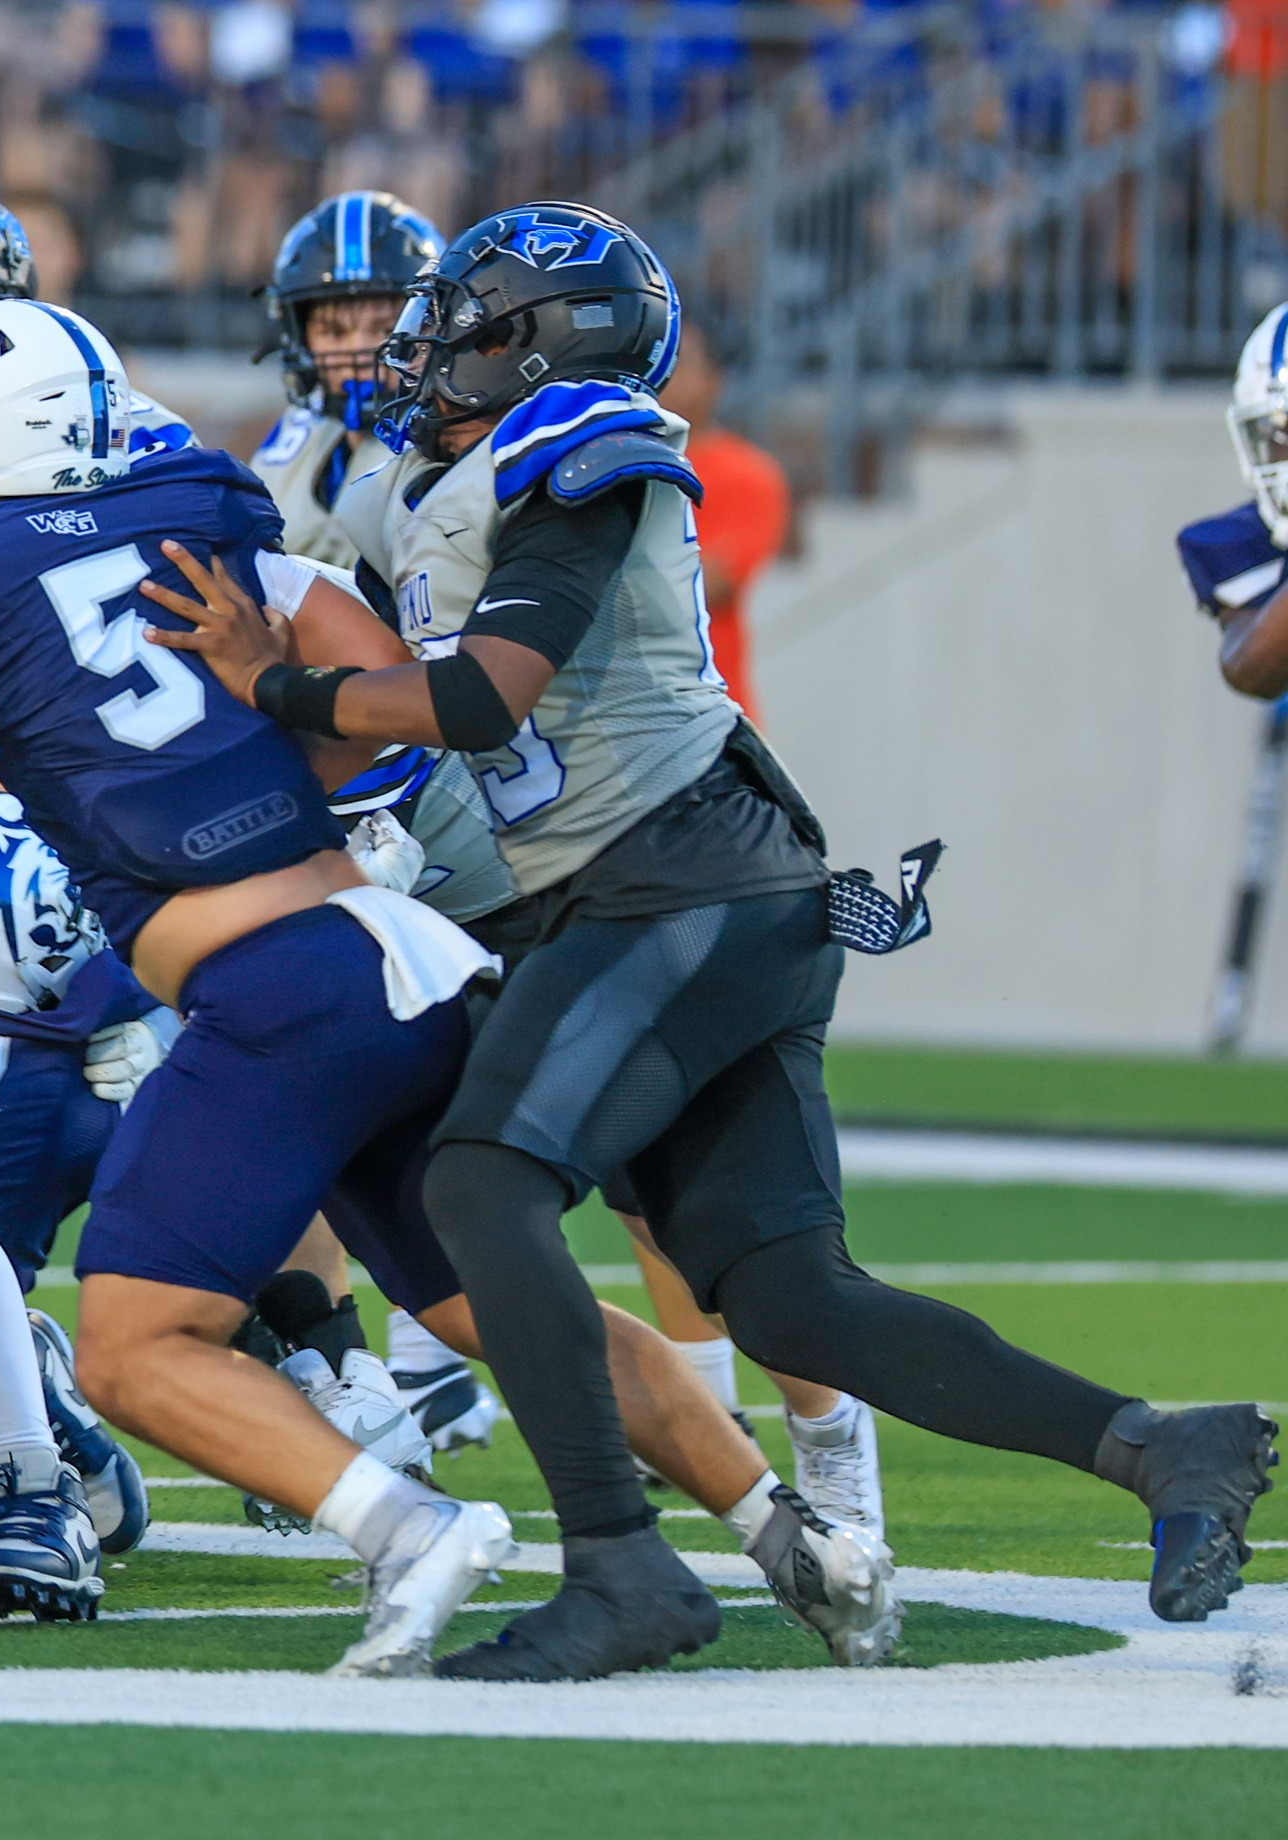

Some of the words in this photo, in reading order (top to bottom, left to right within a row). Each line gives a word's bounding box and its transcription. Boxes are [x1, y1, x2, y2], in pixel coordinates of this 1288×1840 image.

[106, 379, 117, 407] 5
[52, 466, 83, 491] The
[37, 542, 206, 752] 5
[192, 796, 290, 853] BATTLE
